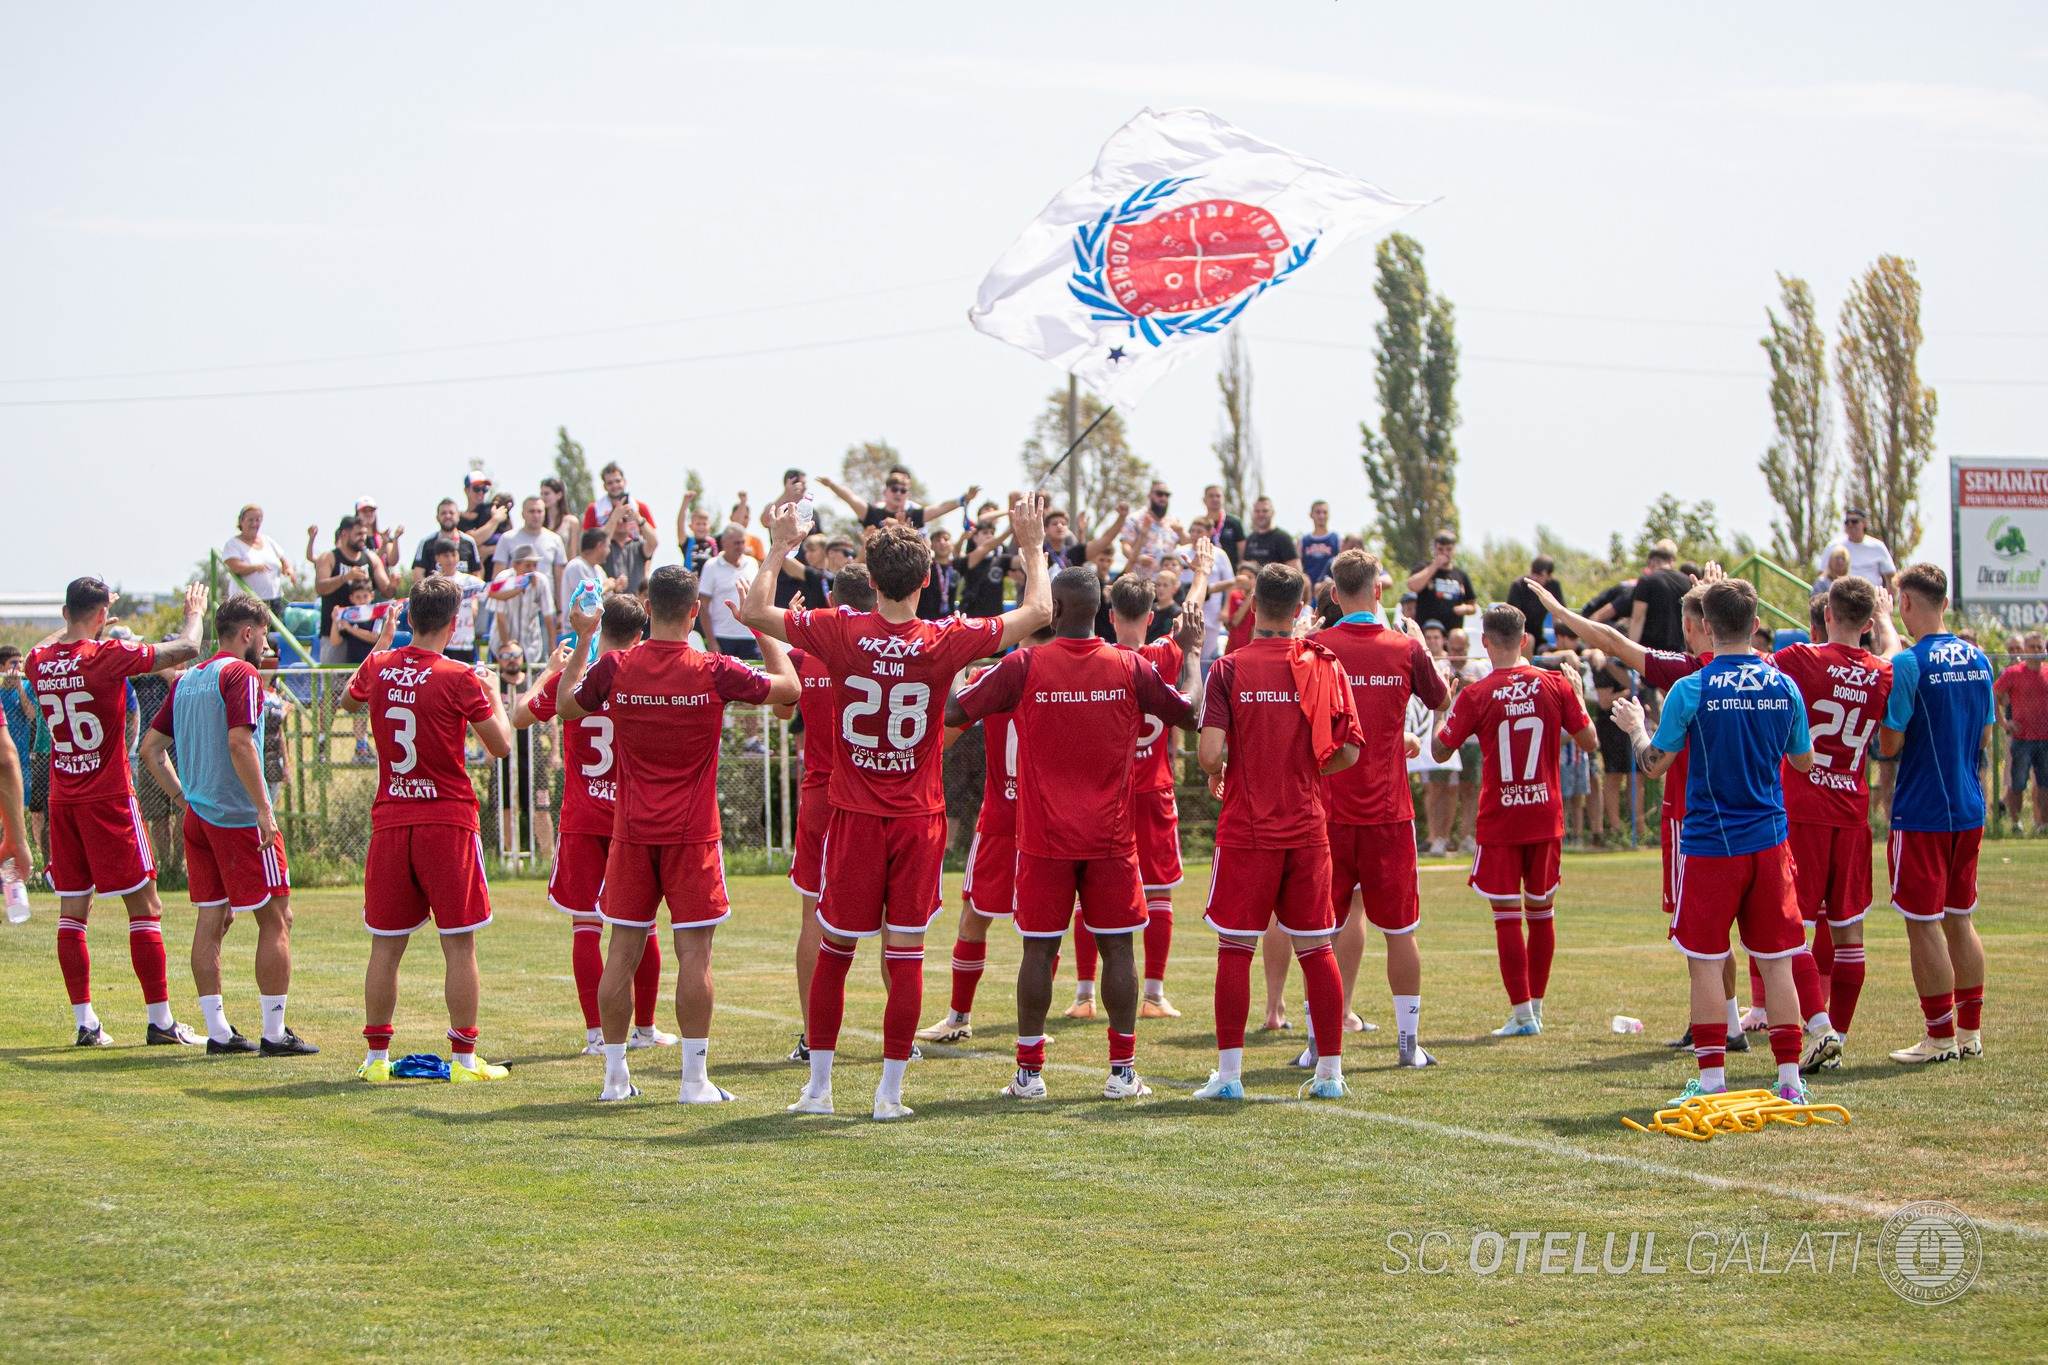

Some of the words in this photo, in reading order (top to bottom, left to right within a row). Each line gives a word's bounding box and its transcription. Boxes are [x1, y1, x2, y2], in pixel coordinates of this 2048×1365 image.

[872, 660, 904, 677] SILVA
[804, 678, 816, 688] SC
[1370, 675, 1403, 686] GALATI
[1929, 673, 1941, 684] SC
[1942, 671, 1967, 682] OTELUL
[387, 688, 416, 704] GALLO
[616, 692, 628, 704] SC
[631, 694, 669, 706] OTELUL
[671, 693, 710, 706] GALATI
[1035, 691, 1048, 703] SC
[1051, 691, 1088, 702] OTELUL
[1090, 688, 1126, 701] GALATI
[1240, 692, 1253, 703] SC
[1256, 691, 1292, 702] OTELUL
[1833, 684, 1868, 704] BORDUN
[1706, 700, 1720, 711] SC
[1722, 698, 1755, 710] OTELUL
[1757, 699, 1789, 710] GALATI
[842, 675, 931, 750] 28
[38, 691, 104, 753] 26
[384, 706, 417, 775] 3
[1809, 698, 1876, 771] 24
[1498, 716, 1544, 782] 17
[588, 779, 609, 789] visit
[1500, 784, 1523, 794] visit
